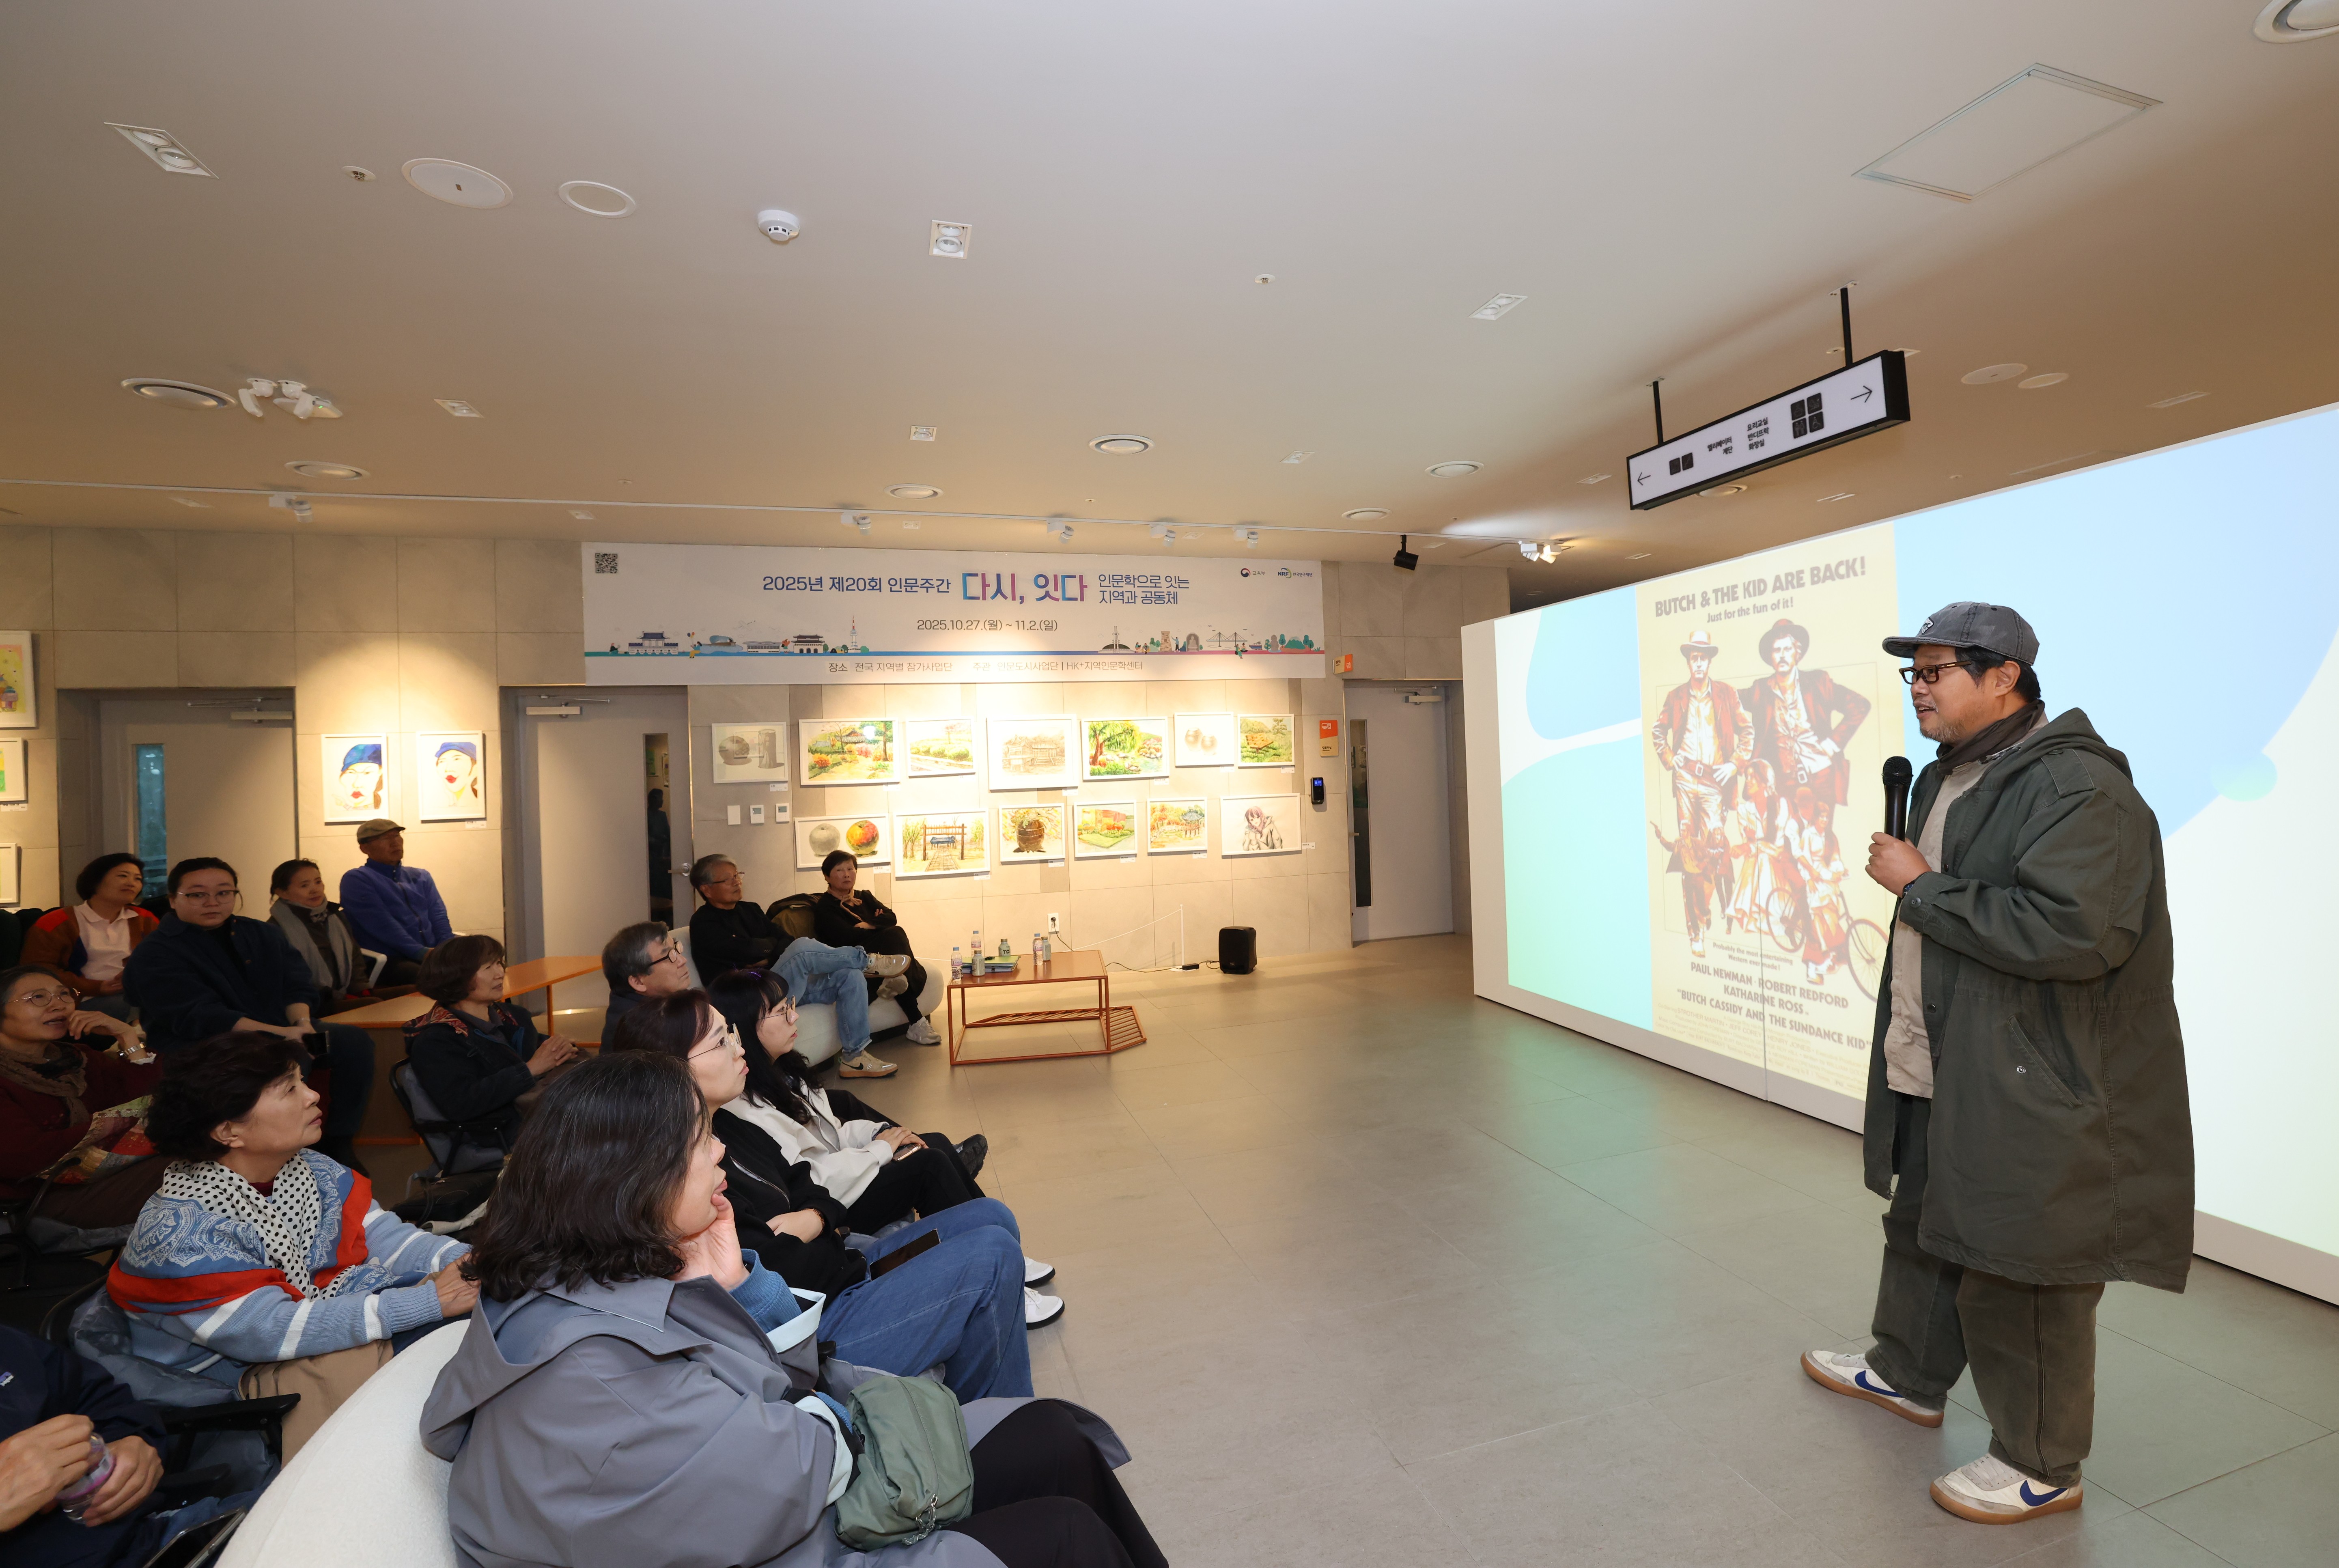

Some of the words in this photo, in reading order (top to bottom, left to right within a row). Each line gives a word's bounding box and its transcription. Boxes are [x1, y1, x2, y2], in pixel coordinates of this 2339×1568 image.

[1747, 417, 1768, 431] 요리교실
[1707, 436, 1732, 452] 엘리베이터
[1723, 446, 1733, 455] 계단
[1748, 438, 1765, 450] 화장실
[762, 576, 823, 592] 2025년
[829, 576, 882, 593] 제20회
[887, 577, 952, 593] 인문주간
[961, 572, 1025, 605] 다시,
[1033, 573, 1088, 602] 잇다
[1098, 574, 1162, 589] 인문학으로
[1165, 575, 1190, 589] 잇는
[1655, 593, 1696, 618] BUTCH
[1700, 590, 1711, 608] &
[1712, 584, 1739, 605] THE
[1742, 578, 1768, 599] KID
[1771, 569, 1806, 594] ARE
[1809, 555, 1866, 586] BACK!
[1098, 590, 1138, 605] 지역과
[1140, 591, 1178, 605] 공동체
[1707, 612, 1722, 624] Just
[1724, 609, 1736, 620] for
[1737, 605, 1751, 618] the
[1752, 603, 1768, 614] fun
[1770, 599, 1781, 611] of
[1782, 596, 1794, 609] it!
[917, 619, 1003, 632] 2025.10.27.(월)
[1015, 620, 1058, 632] 11.2.(일)
[828, 662, 848, 672] 장소
[855, 662, 874, 672] 전국
[876, 662, 904, 672] 지역별
[906, 662, 953, 672] 참가사업단
[972, 662, 991, 672] 주관
[997, 661, 1059, 672] 인문도시사업단
[1066, 661, 1143, 671] HK+지역인문학센터
[1712, 942, 1736, 954] Probably
[1736, 946, 1745, 954] the
[1746, 949, 1759, 958] most
[1728, 953, 1748, 964] Western
[1691, 962, 1712, 976] PAUL
[1713, 966, 1752, 986] NEWMAN
[1758, 978, 1797, 997] ROBERT
[1799, 986, 1849, 1009] REDFORD
[1724, 984, 1775, 1008] KATHARINE
[1778, 998, 1804, 1015] ROSS
[1677, 989, 1707, 1006] "BUTCH
[1709, 997, 1743, 1016] CASSIDY
[1745, 1008, 1764, 1022] AND
[1768, 1014, 1788, 1028] THE
[1789, 1019, 1844, 1045] SUNDANCE
[1846, 1035, 1872, 1051] KID"
[1728, 1023, 1742, 1032] JEFF
